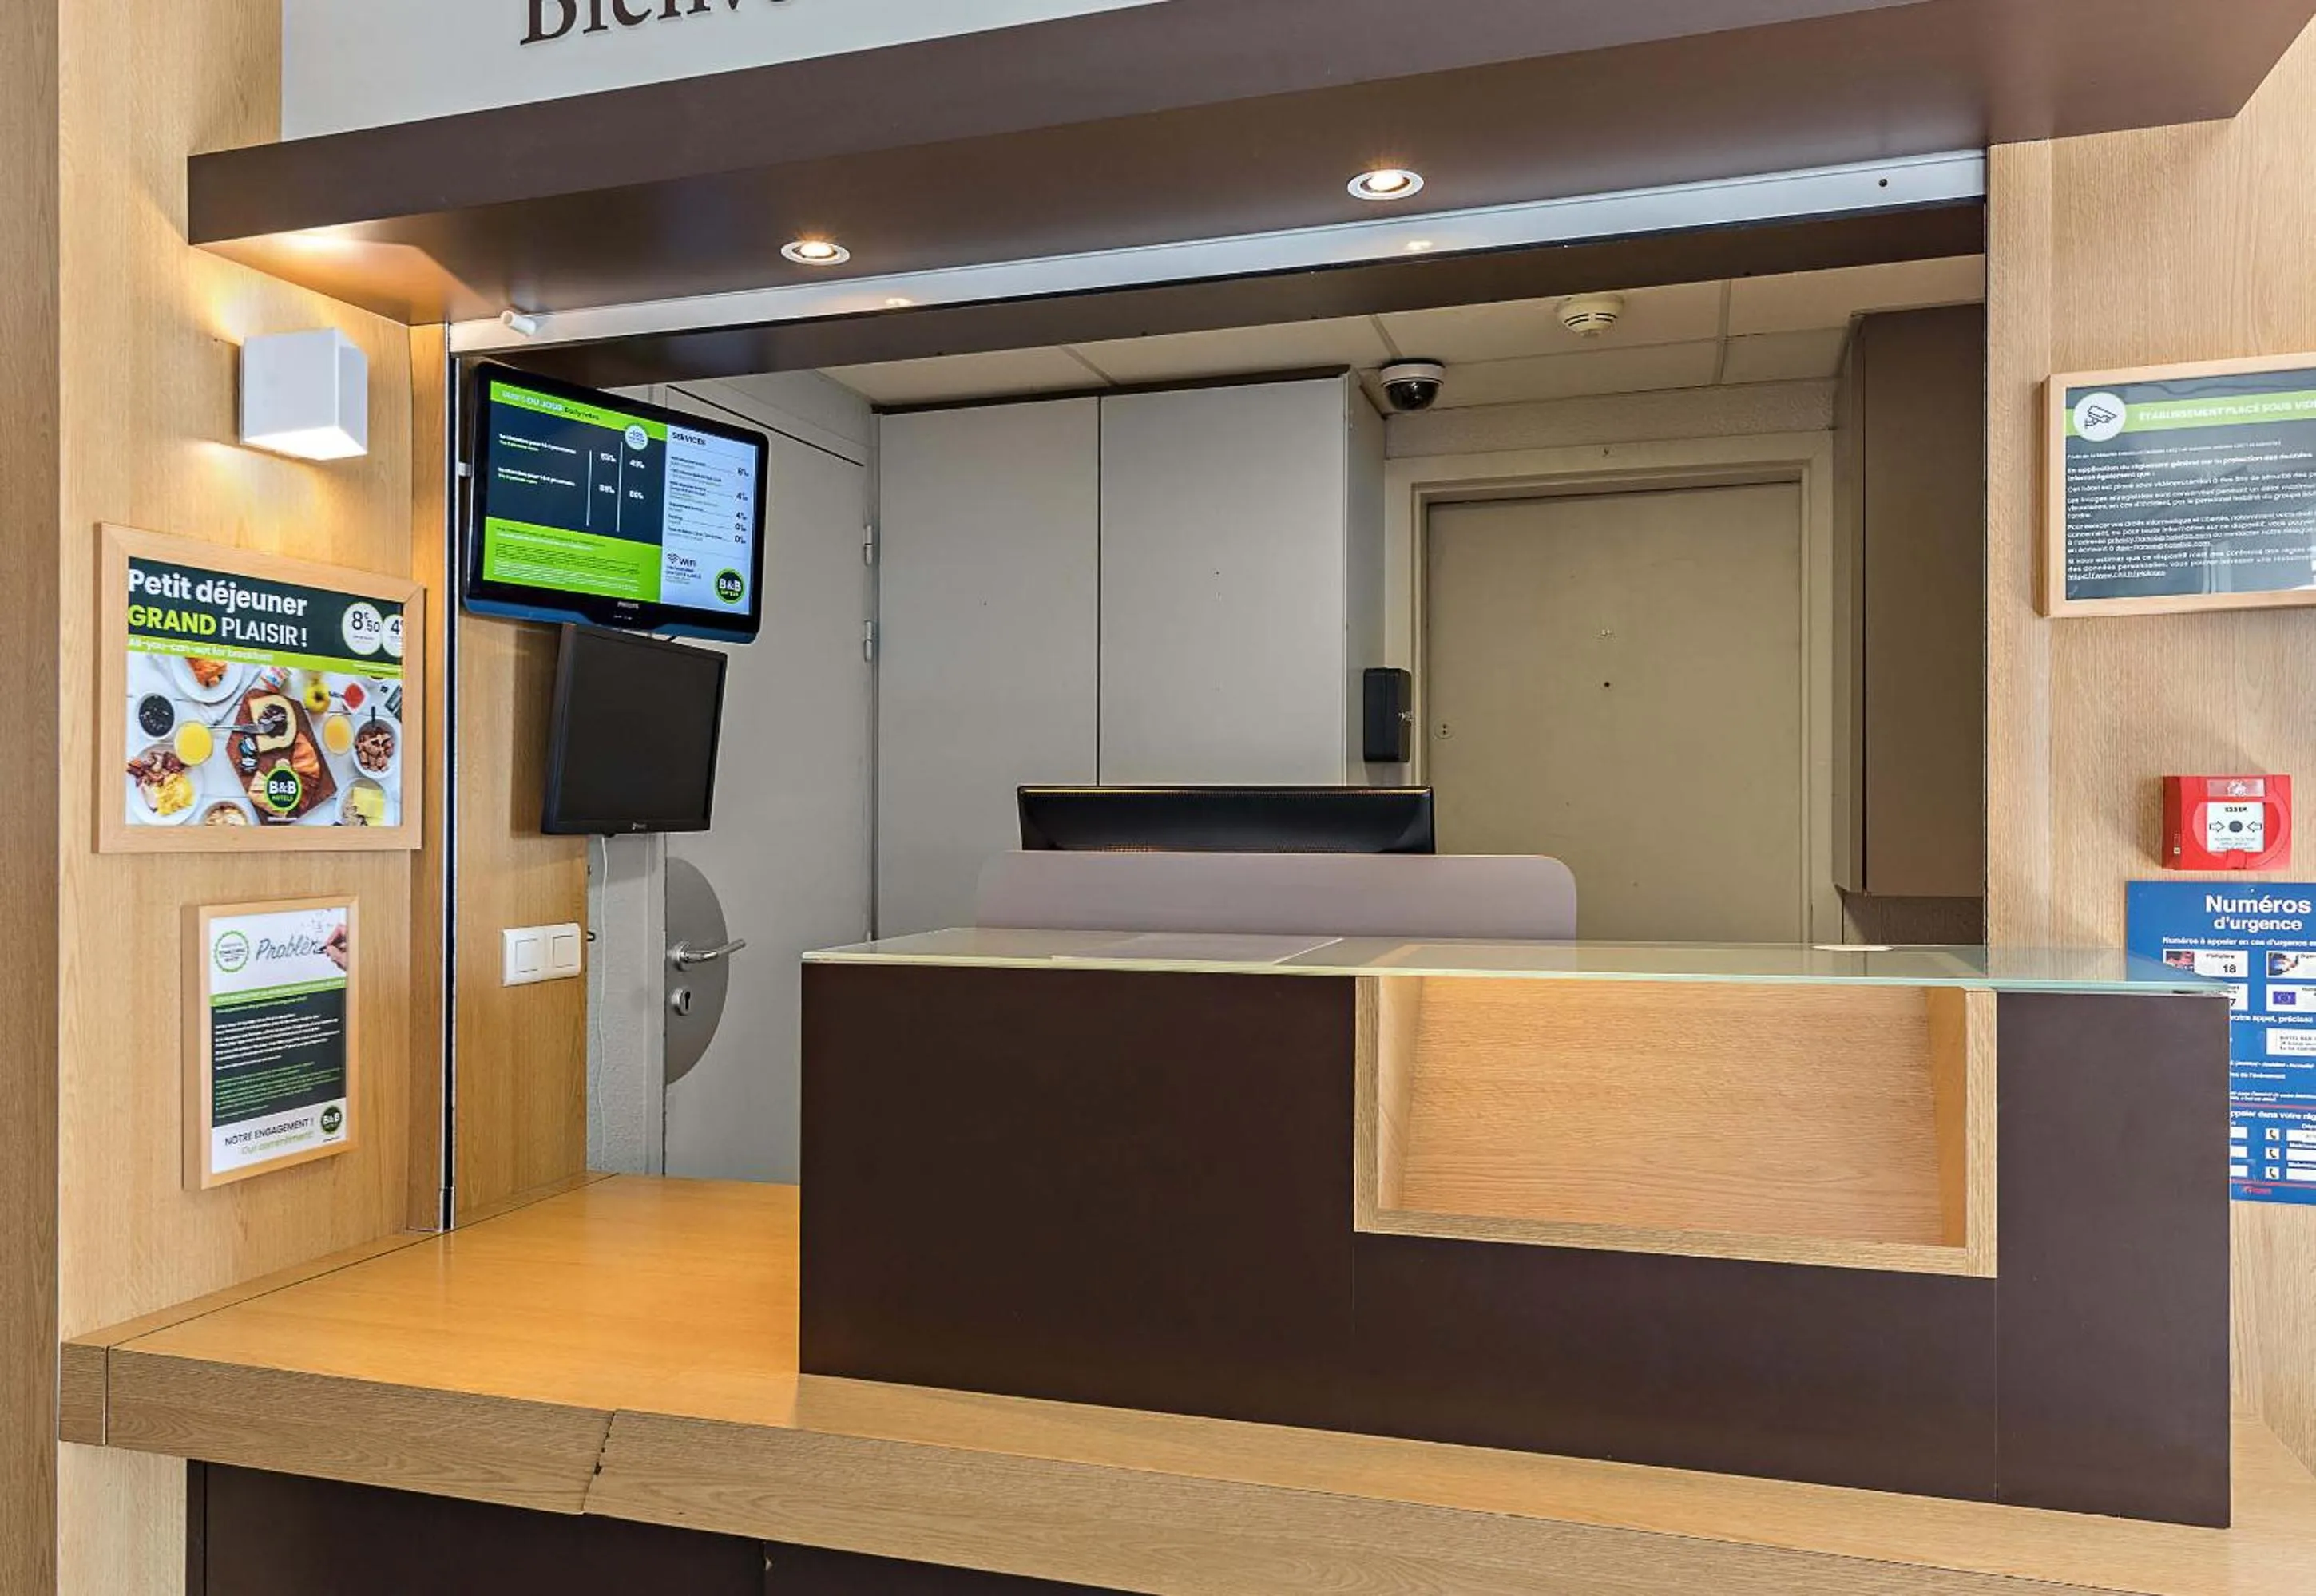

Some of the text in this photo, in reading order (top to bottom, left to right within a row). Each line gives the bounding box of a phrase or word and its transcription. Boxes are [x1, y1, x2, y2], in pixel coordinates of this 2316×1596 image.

[128, 568, 308, 616] Petit déjeuner
[719, 578, 741, 592] B&B
[128, 604, 217, 636] GRAND
[268, 780, 297, 794] B&B
[2205, 895, 2312, 914] Numéros
[2214, 917, 2303, 933] d'urgence
[2223, 964, 2237, 974] 18
[224, 1131, 252, 1146] NOTRE
